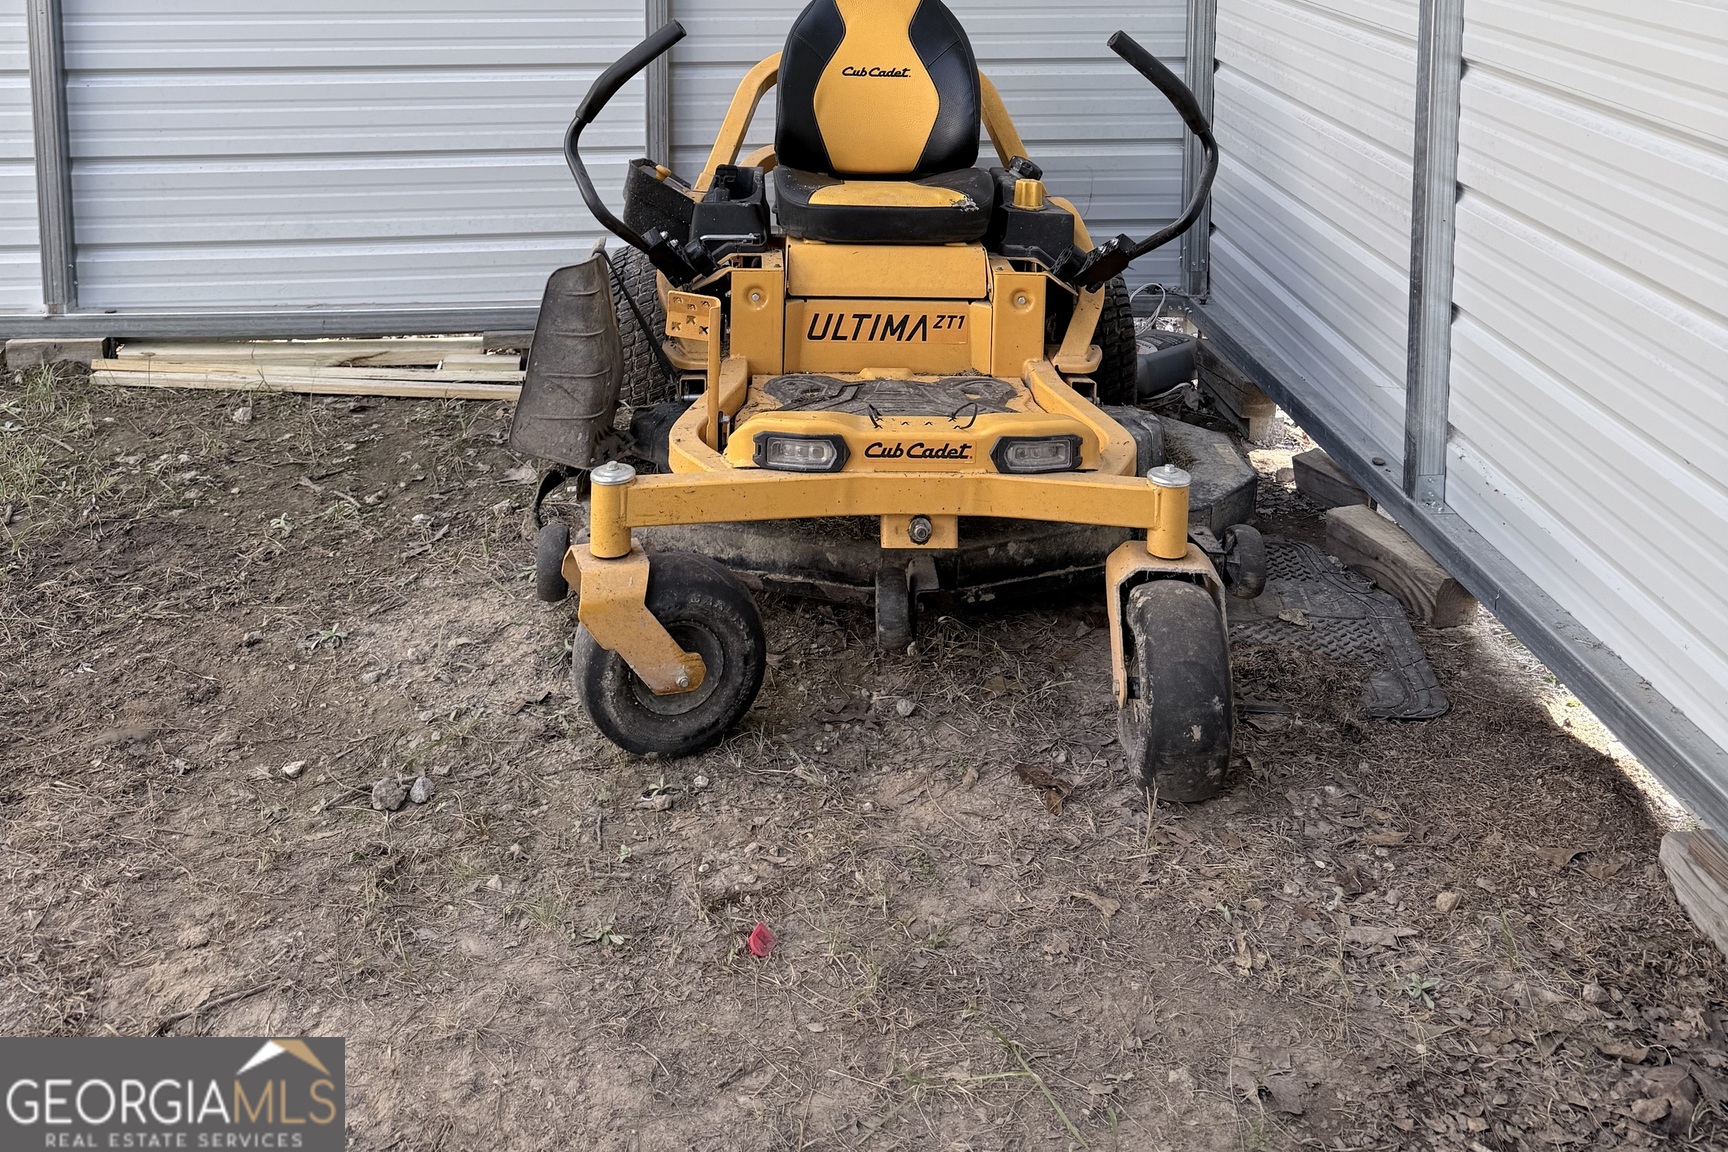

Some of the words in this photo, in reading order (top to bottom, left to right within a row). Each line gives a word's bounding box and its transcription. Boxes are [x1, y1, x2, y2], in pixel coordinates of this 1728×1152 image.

[842, 66, 867, 77] Cub
[806, 313, 927, 342] ULTIMA
[932, 315, 966, 330] ZT1
[864, 442, 904, 459] Cub
